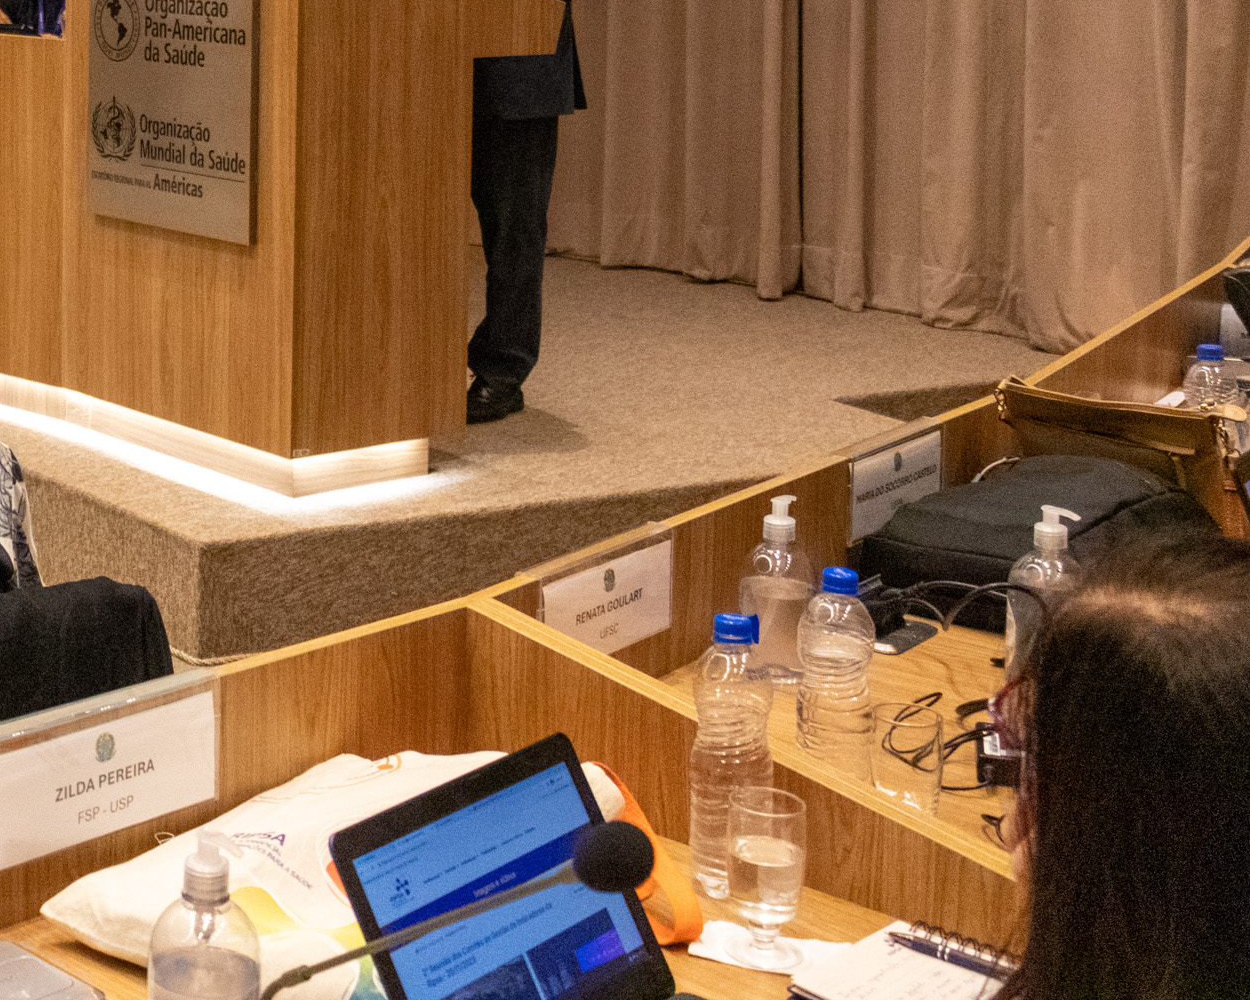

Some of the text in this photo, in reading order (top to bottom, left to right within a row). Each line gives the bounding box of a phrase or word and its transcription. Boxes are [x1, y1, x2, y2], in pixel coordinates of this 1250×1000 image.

[144, 17, 245, 46] Pan-Americana
[144, 41, 160, 62] da
[164, 42, 205, 67] Saúde
[140, 113, 210, 146] Organização
[140, 139, 245, 175] Mundial da Saúde
[153, 172, 203, 198] Américas
[576, 588, 643, 626] RENATA GOULART
[600, 623, 618, 639] UFSC
[55, 759, 155, 803] ZILDA PEREIRA
[77, 806, 99, 824] FSP
[110, 794, 135, 814] USP
